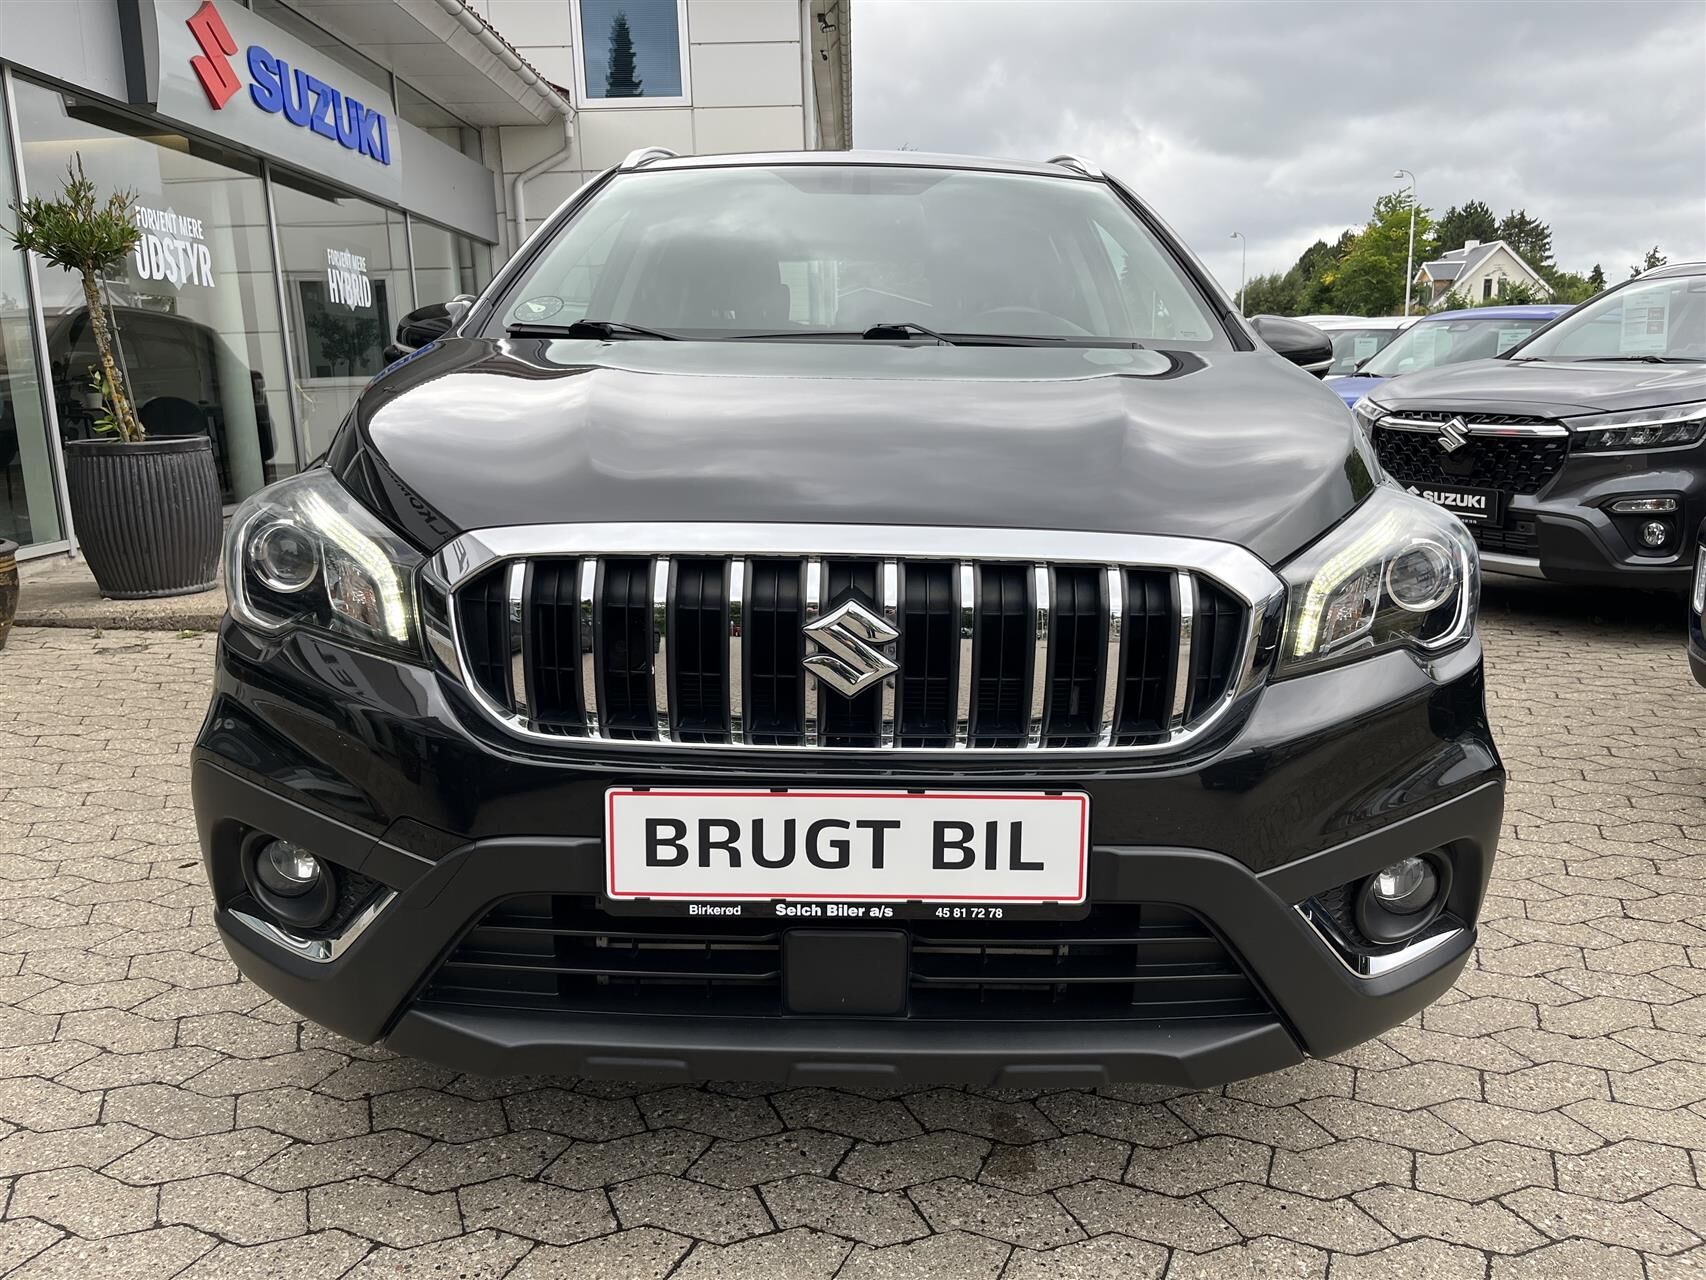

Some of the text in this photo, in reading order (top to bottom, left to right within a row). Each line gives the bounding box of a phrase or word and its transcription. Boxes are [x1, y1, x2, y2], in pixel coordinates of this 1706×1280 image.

[246, 45, 391, 165] SUZUKI
[135, 205, 204, 240] FORVENT MERE
[134, 233, 216, 288] UDSTYR
[327, 268, 372, 308] HYBRID
[1422, 490, 1486, 509] SUZUKI
[645, 817, 1045, 872] BRUGT BIL
[689, 903, 1003, 919] Birkerød Selch Biler a/s 45 81 72 78
